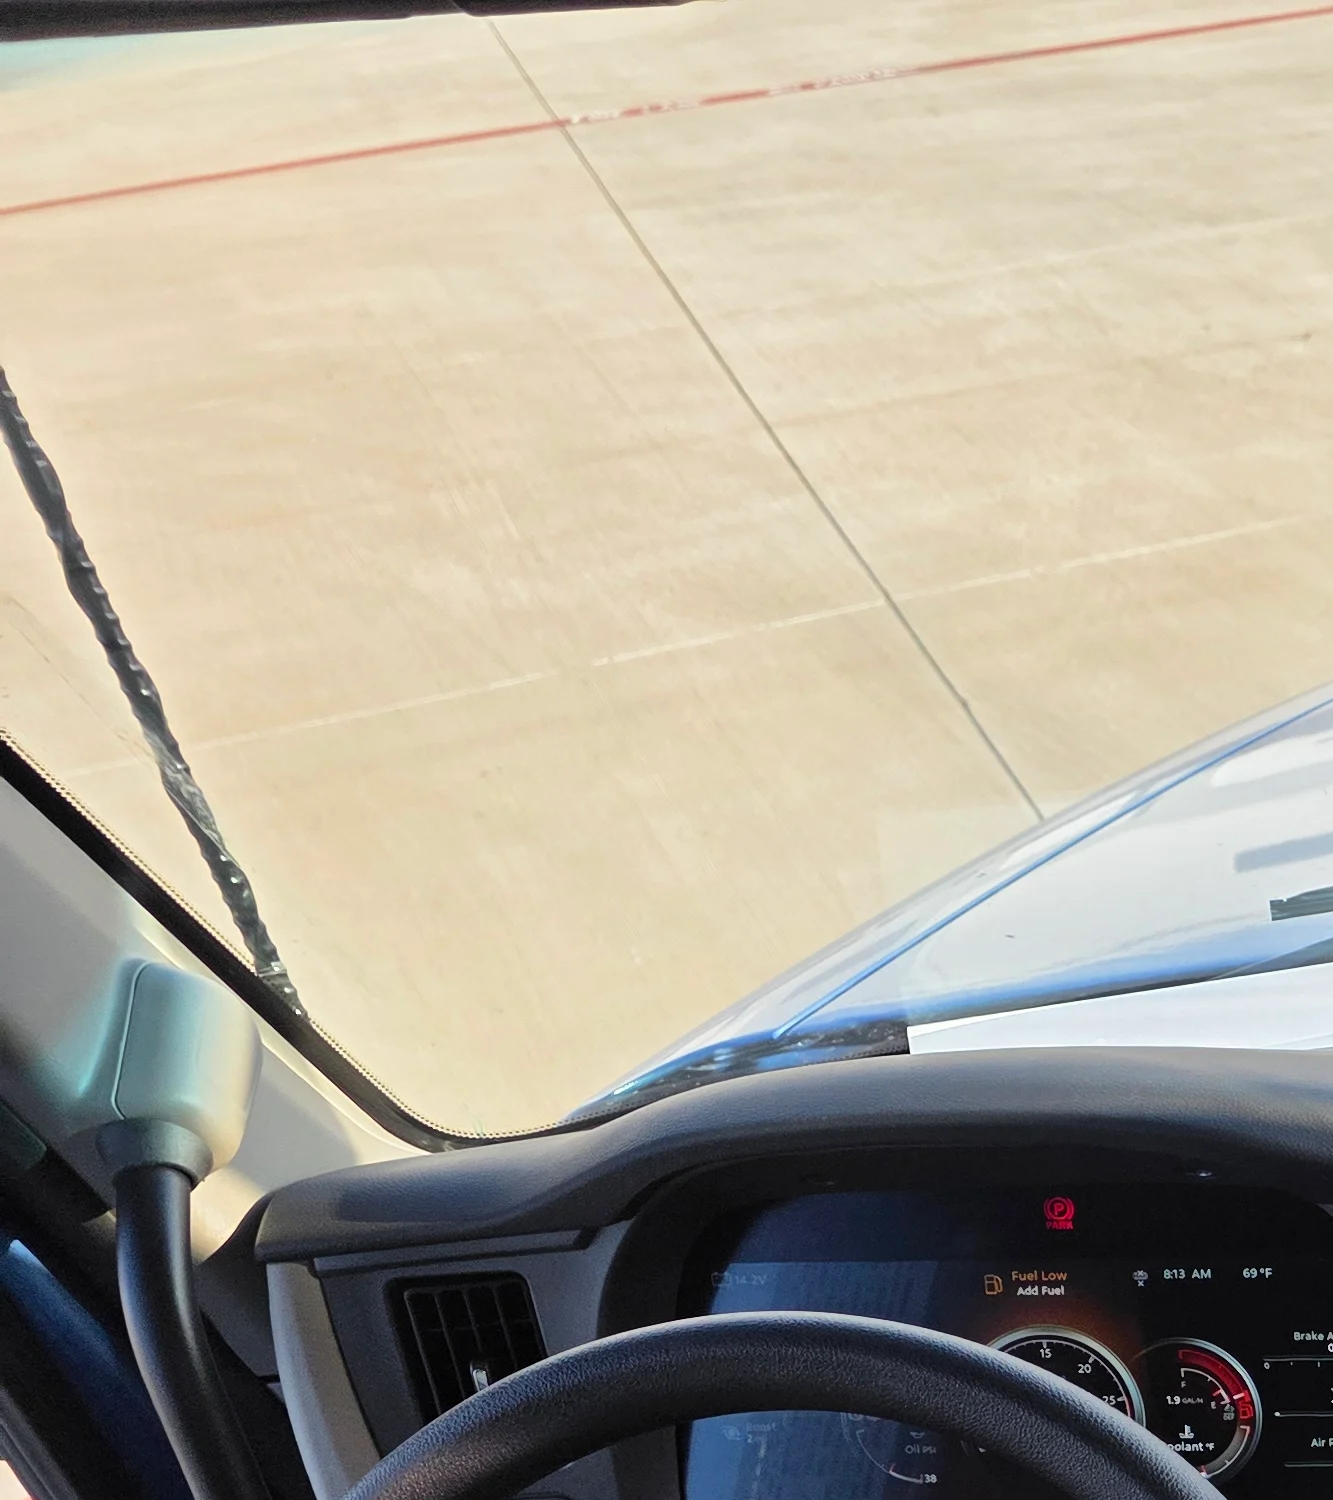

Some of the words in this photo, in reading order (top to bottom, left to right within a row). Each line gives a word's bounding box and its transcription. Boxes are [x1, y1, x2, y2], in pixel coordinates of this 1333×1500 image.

[1046, 1221, 1073, 1230] PARK
[1011, 1270, 1038, 1281] Fuel
[1041, 1271, 1068, 1281] Low
[1163, 1268, 1186, 1280] 8:13
[1191, 1268, 1212, 1279] AM
[1017, 1285, 1039, 1296] Add
[1041, 1285, 1065, 1296] Fuel
[1293, 1331, 1324, 1341] Brake
[1039, 1349, 1052, 1359] 15
[1077, 1364, 1092, 1374] 20
[1263, 1361, 1270, 1370] 0
[1102, 1395, 1116, 1405] 25
[1166, 1395, 1181, 1405] 1.9
[1167, 1441, 1204, 1451] oolant
[1310, 1437, 1326, 1447] Air
[905, 1444, 920, 1454] Oil
[922, 1445, 937, 1454] PSI
[924, 1474, 937, 1483] 38
